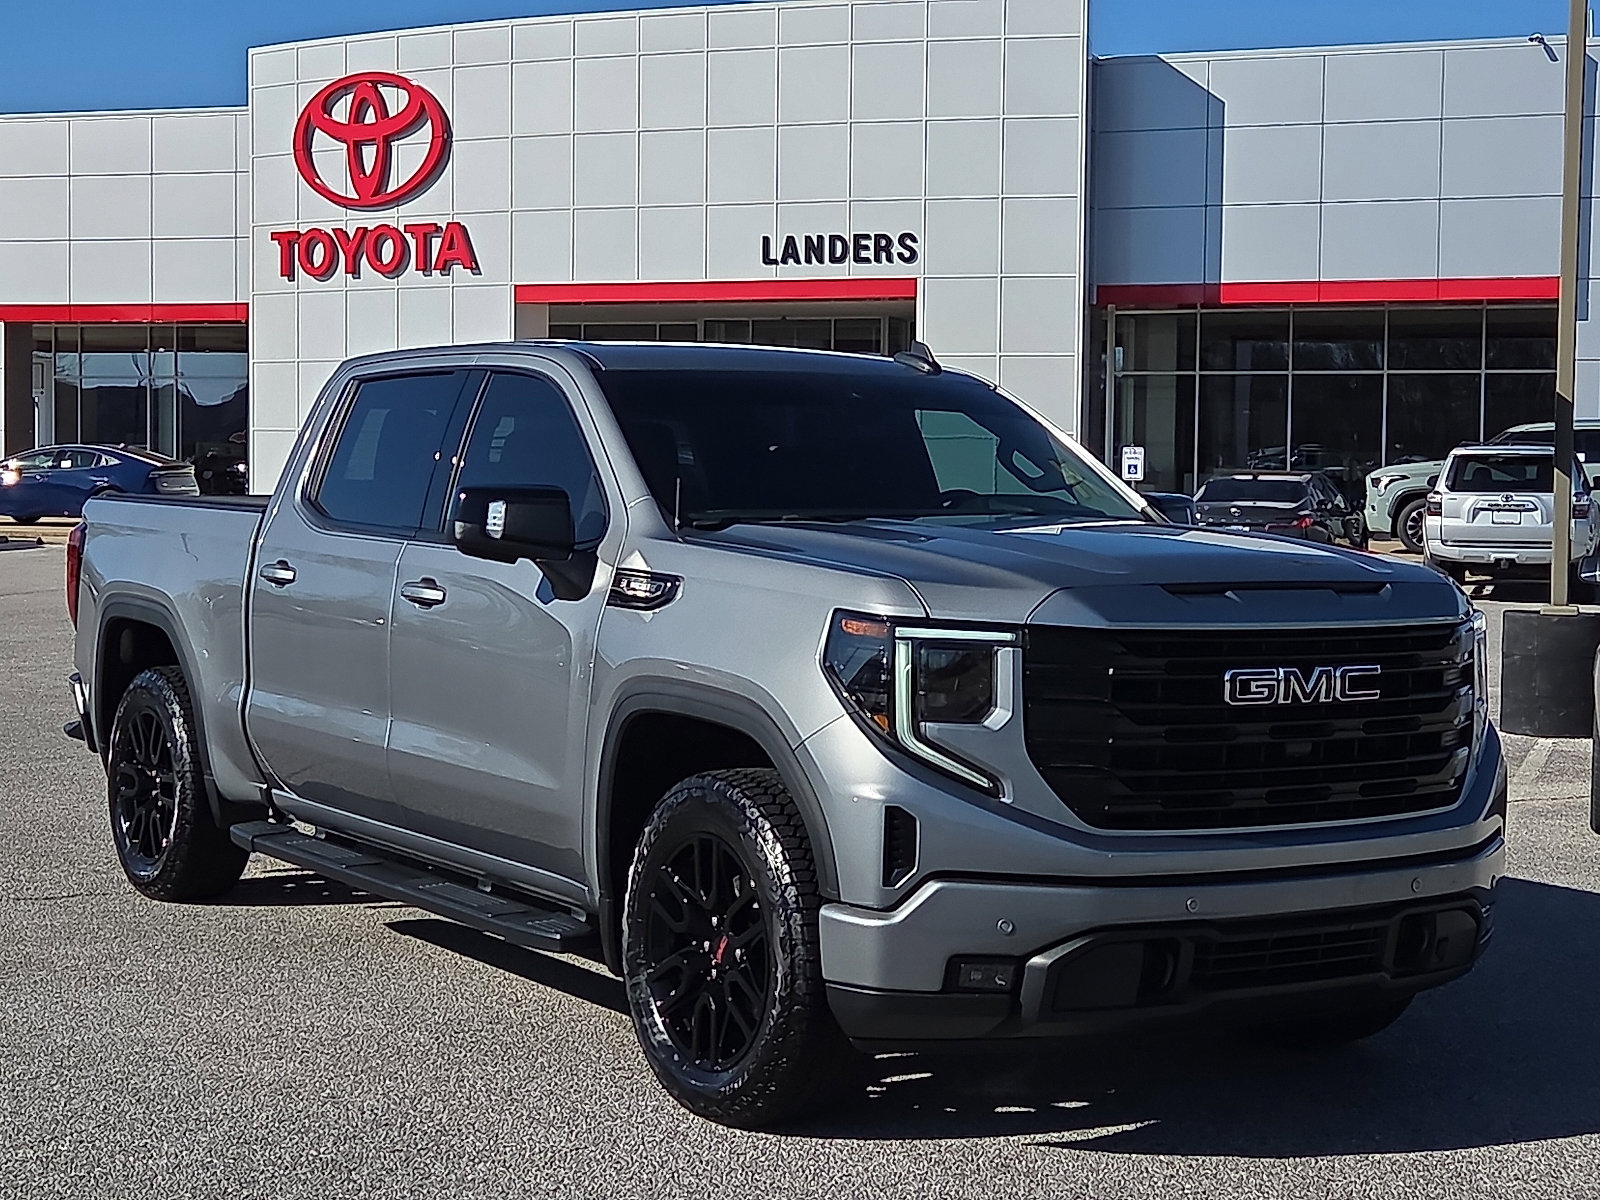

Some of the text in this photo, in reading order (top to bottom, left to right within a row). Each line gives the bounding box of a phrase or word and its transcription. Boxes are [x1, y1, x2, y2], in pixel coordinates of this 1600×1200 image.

[270, 222, 479, 281] TOYOTA
[762, 232, 919, 266] LANDERS
[1224, 665, 1381, 705] GMC
